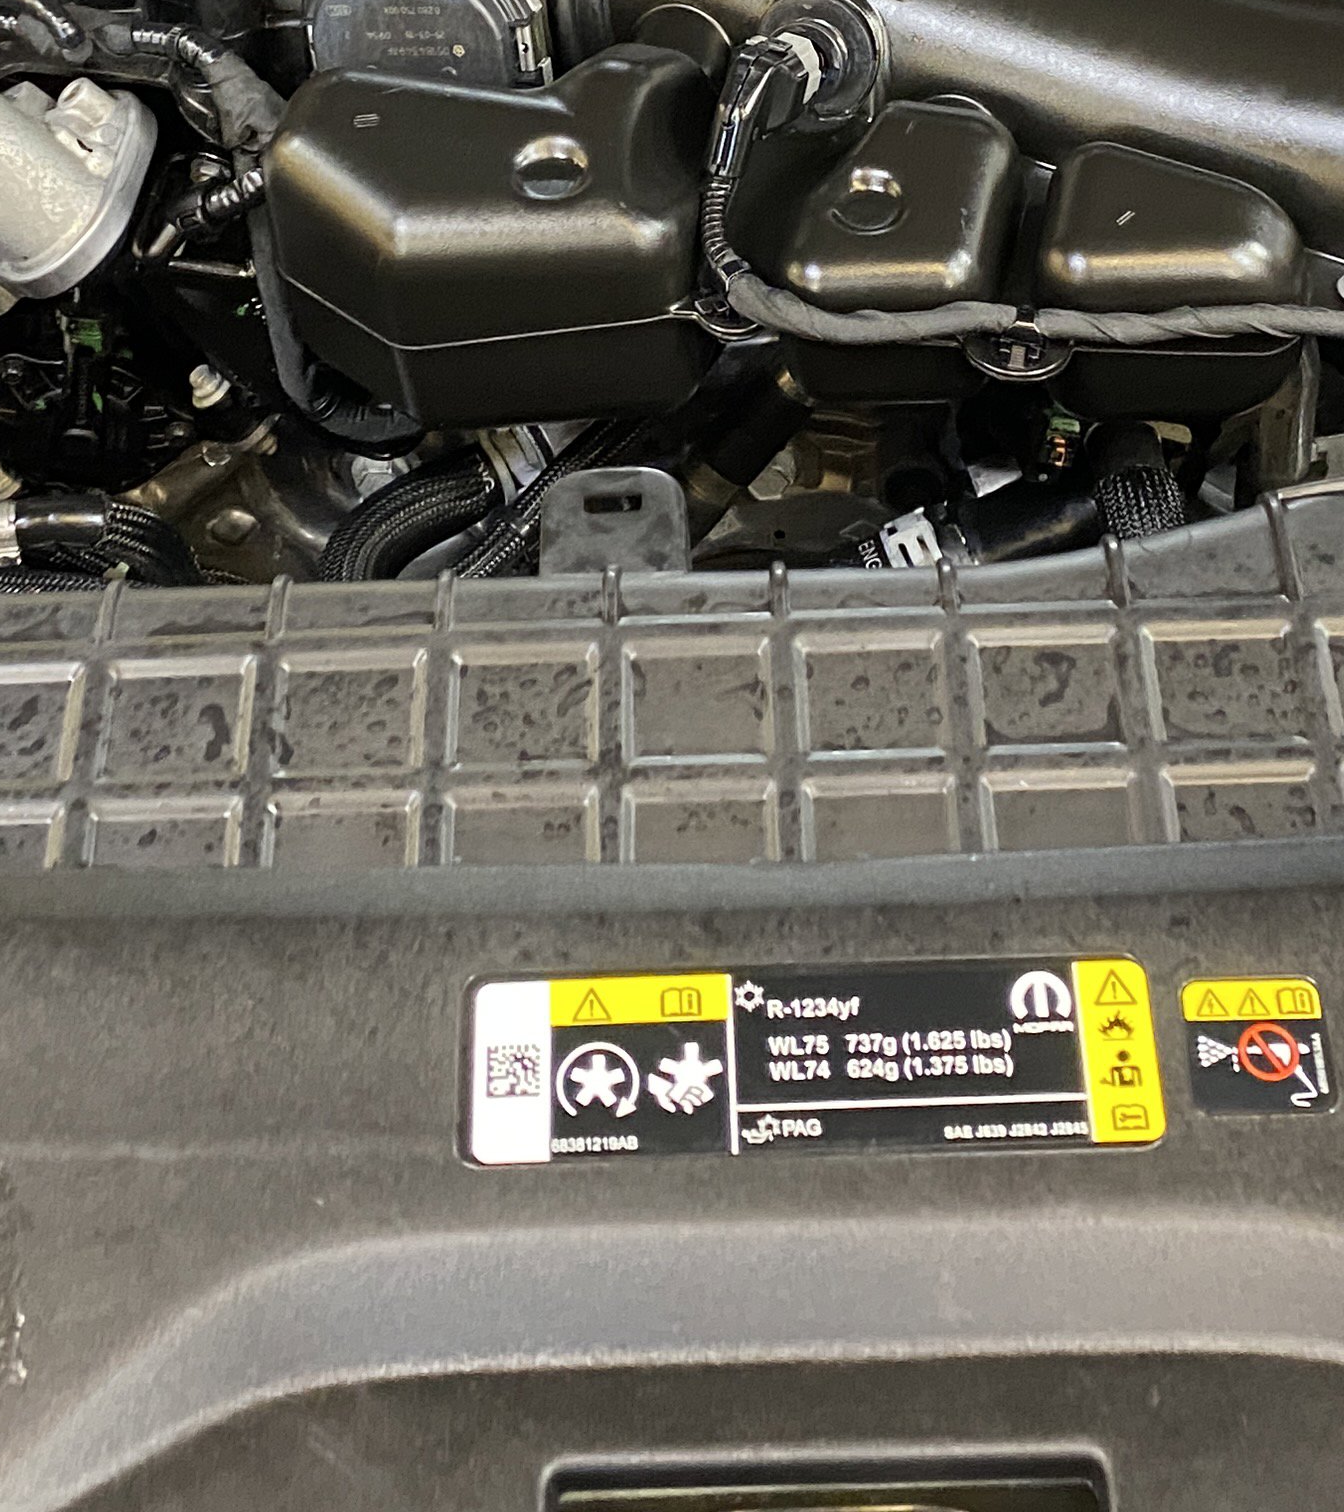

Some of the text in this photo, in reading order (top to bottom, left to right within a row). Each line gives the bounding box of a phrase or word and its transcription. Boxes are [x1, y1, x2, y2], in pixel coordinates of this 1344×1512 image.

[766, 996, 860, 1021] R-1234yf
[767, 1028, 1012, 1056] WL75 737g (1.625 lbs)
[768, 1053, 1014, 1083] WL74 624g (1.375 lbs)
[781, 1117, 823, 1138] PAG
[943, 1125, 974, 1140] SAE
